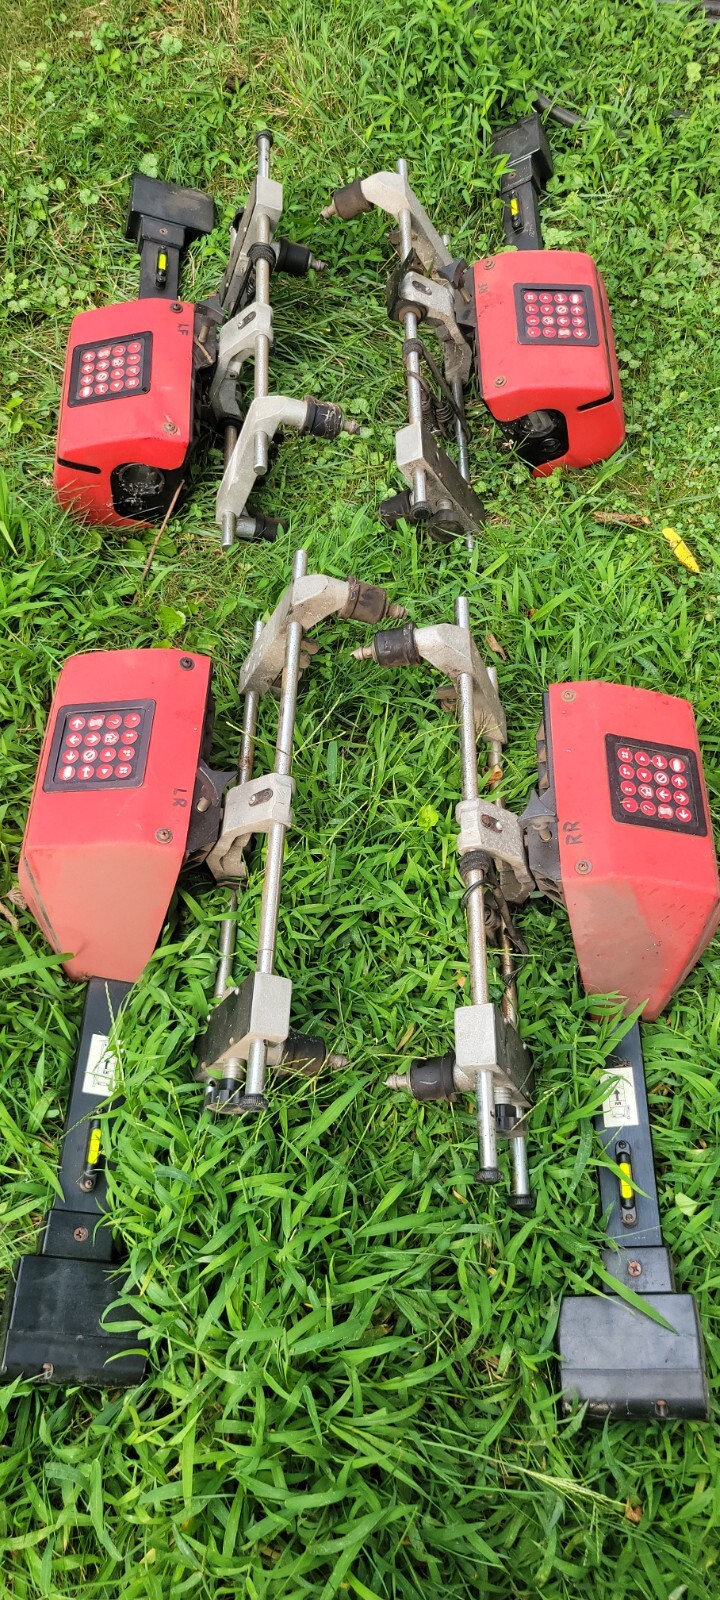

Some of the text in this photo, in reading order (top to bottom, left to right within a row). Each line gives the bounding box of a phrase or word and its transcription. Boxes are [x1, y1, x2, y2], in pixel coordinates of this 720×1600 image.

[177, 323, 189, 336] LF
[172, 788, 188, 807] LR
[562, 821, 584, 845] RR
